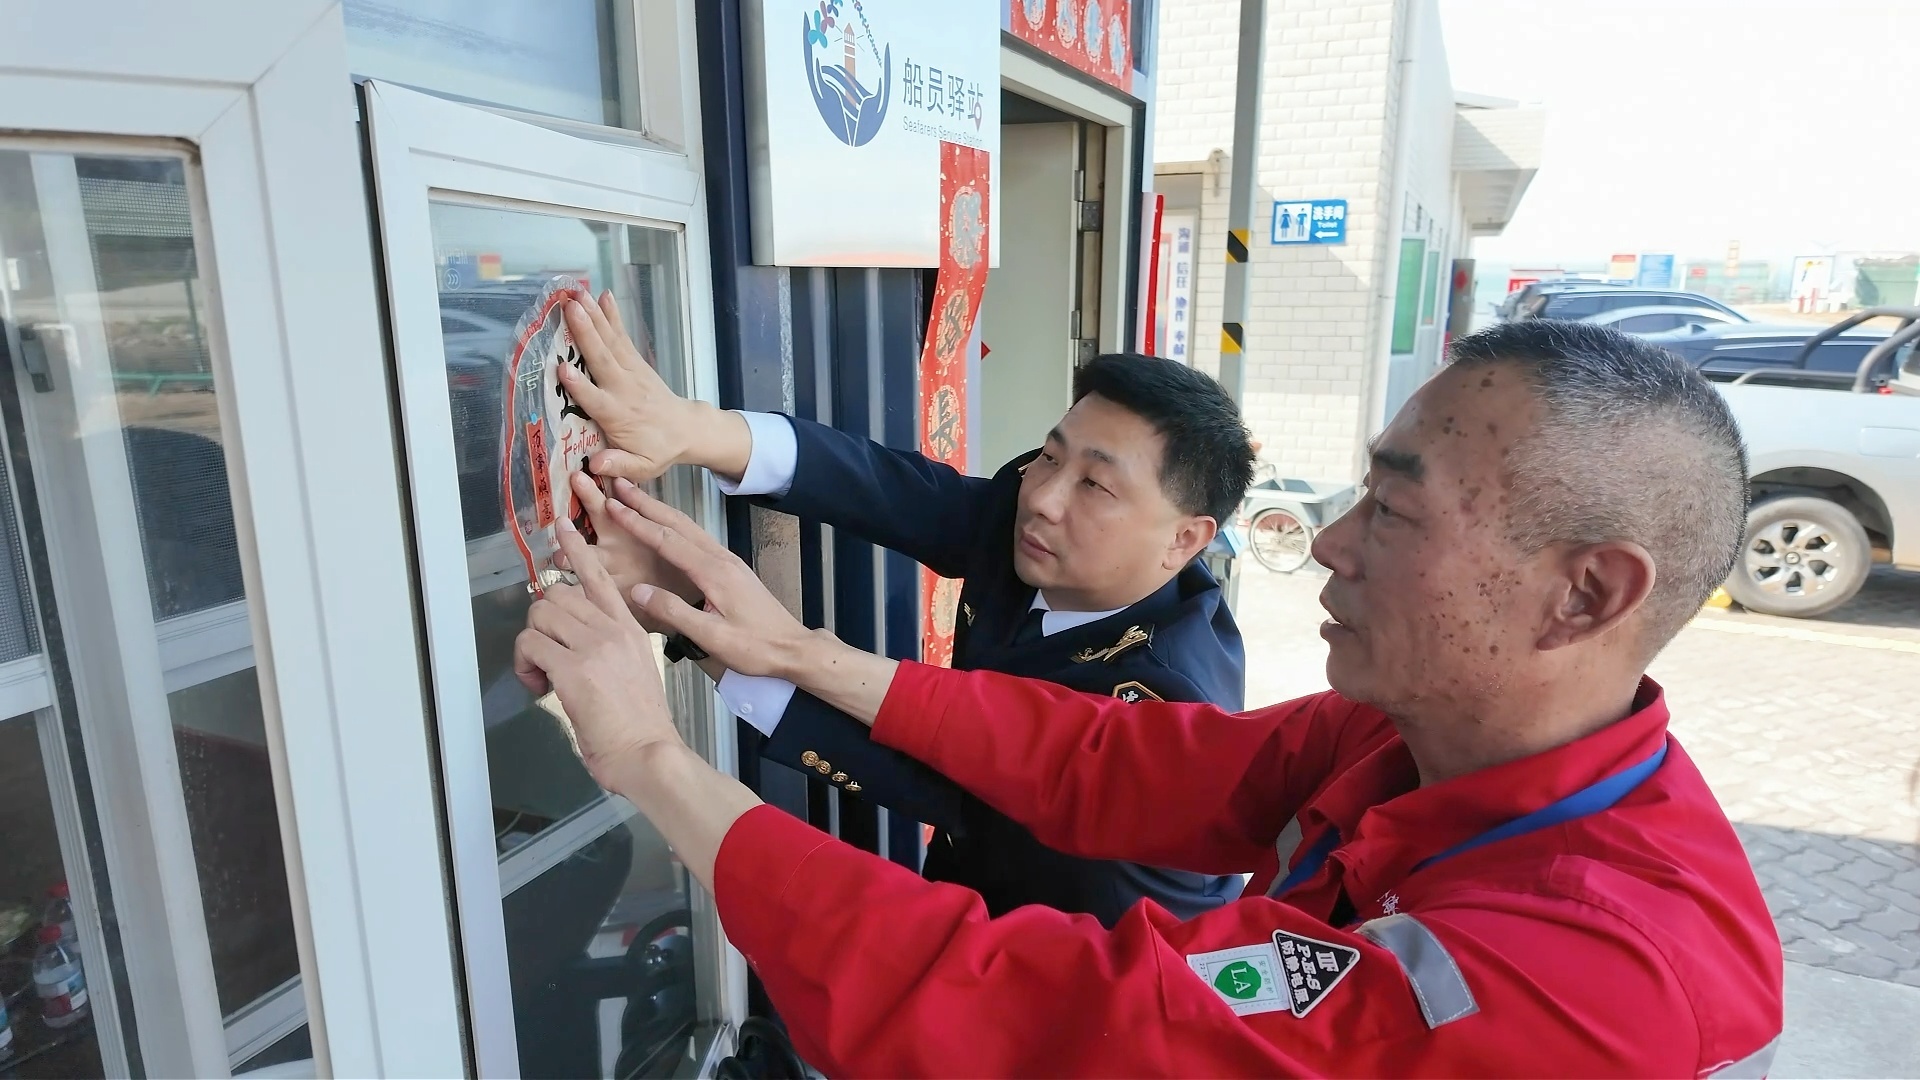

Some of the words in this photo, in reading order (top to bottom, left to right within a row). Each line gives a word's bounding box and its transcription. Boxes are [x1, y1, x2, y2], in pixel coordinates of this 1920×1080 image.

[903, 57, 984, 120] 船员驿站
[903, 115, 938, 138] Seafarers
[1312, 205, 1345, 221] 洗手间
[1317, 221, 1338, 229] Toilet
[1231, 967, 1252, 994] LA
[1258, 960, 1274, 994] 安全防护
[1280, 940, 1309, 1005] 防静电服
